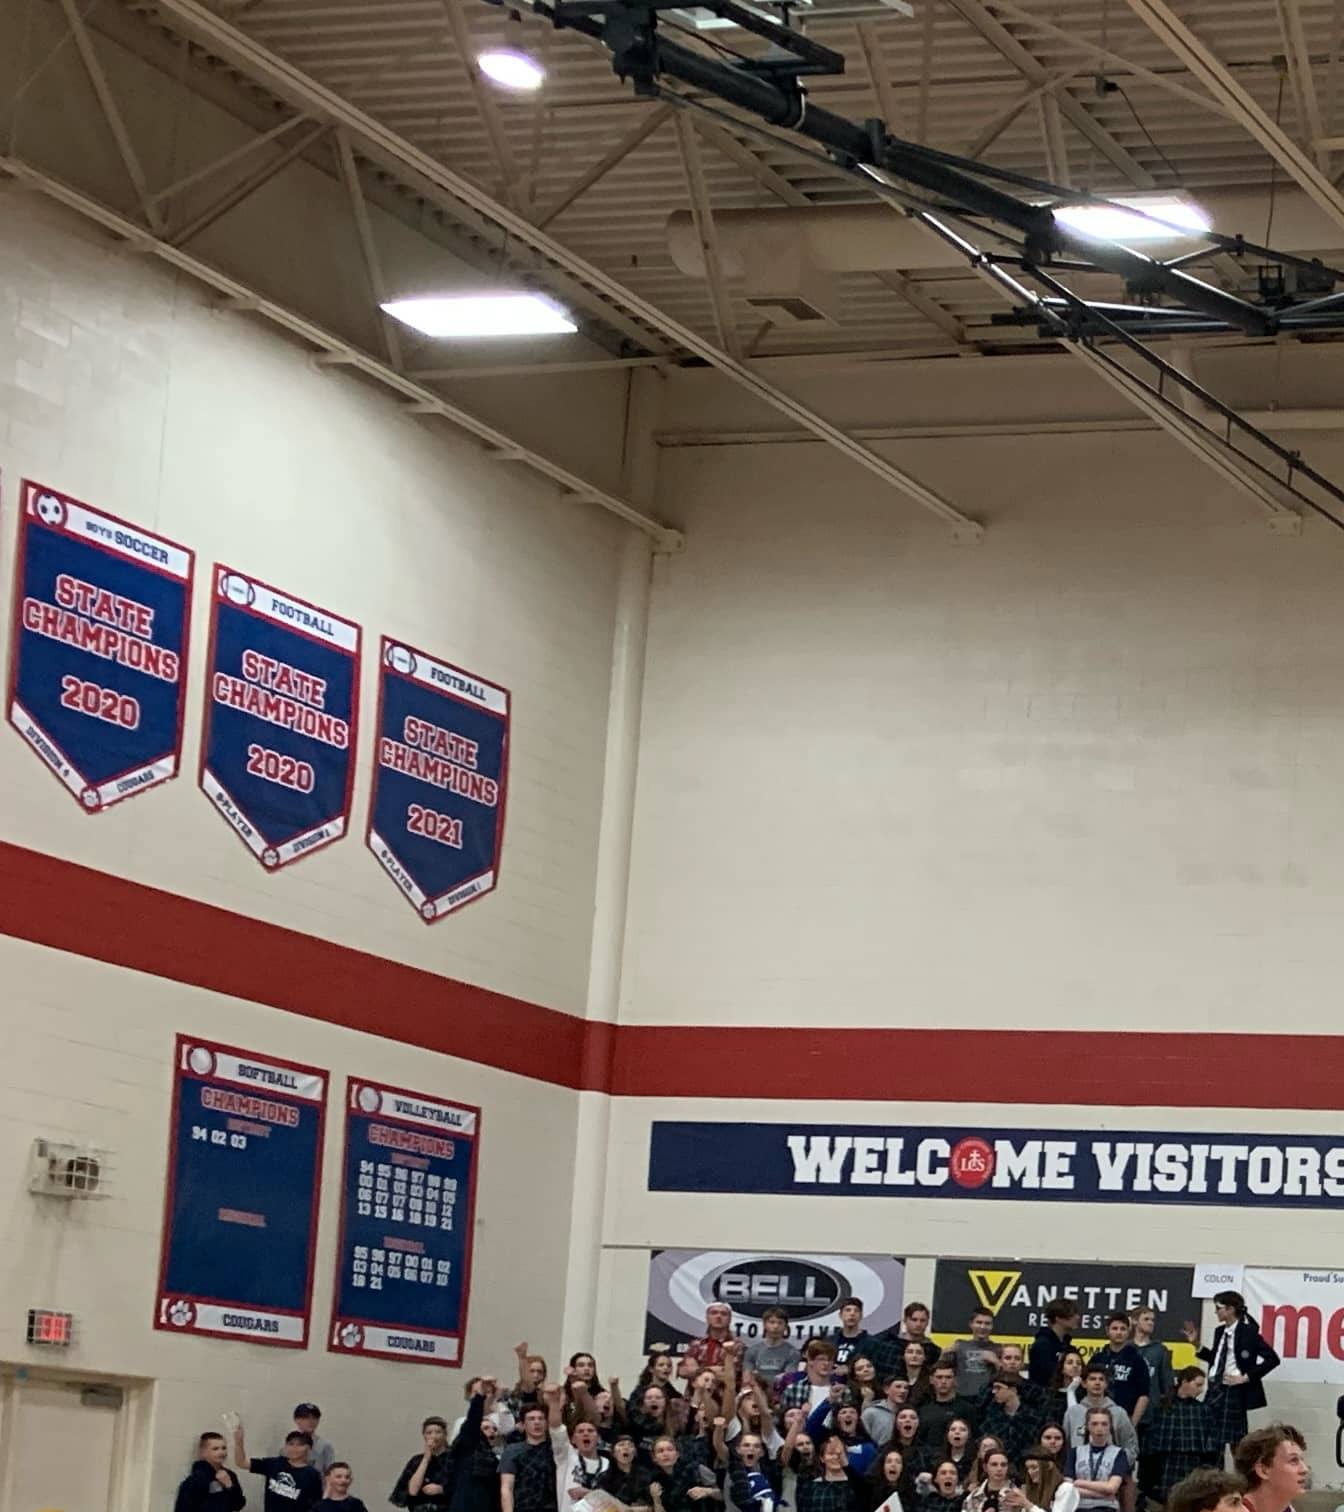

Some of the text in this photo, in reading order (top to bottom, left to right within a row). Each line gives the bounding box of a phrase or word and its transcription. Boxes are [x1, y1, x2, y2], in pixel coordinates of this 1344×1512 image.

[115, 531, 168, 564] SOCCER
[56, 574, 154, 641] STATE
[272, 599, 334, 636] FOOTBALL
[23, 598, 179, 683] CHAMPIONS
[242, 650, 326, 709] STATE
[431, 667, 486, 701] FOOTBALL
[61, 675, 140, 730] 2020
[214, 672, 349, 749] CHAMPIONS
[404, 715, 478, 770] STATE
[247, 744, 314, 794] 2020
[380, 737, 498, 806] CHAMPIONS
[407, 804, 462, 849] 2021
[238, 1064, 298, 1089] SOFTBALL
[201, 1087, 300, 1127] CHAMPIONS
[393, 1099, 462, 1126] VOLLEYBALL
[211, 1131, 226, 1145] 02
[231, 1134, 246, 1149] 03
[369, 1123, 454, 1160] CHAMPIONS
[719, 1273, 830, 1306] BELL
[1204, 1274, 1234, 1284] COLON
[1304, 1273, 1330, 1282] Proud
[223, 1314, 279, 1332] COUGARS
[387, 1335, 435, 1353] COUGARS
